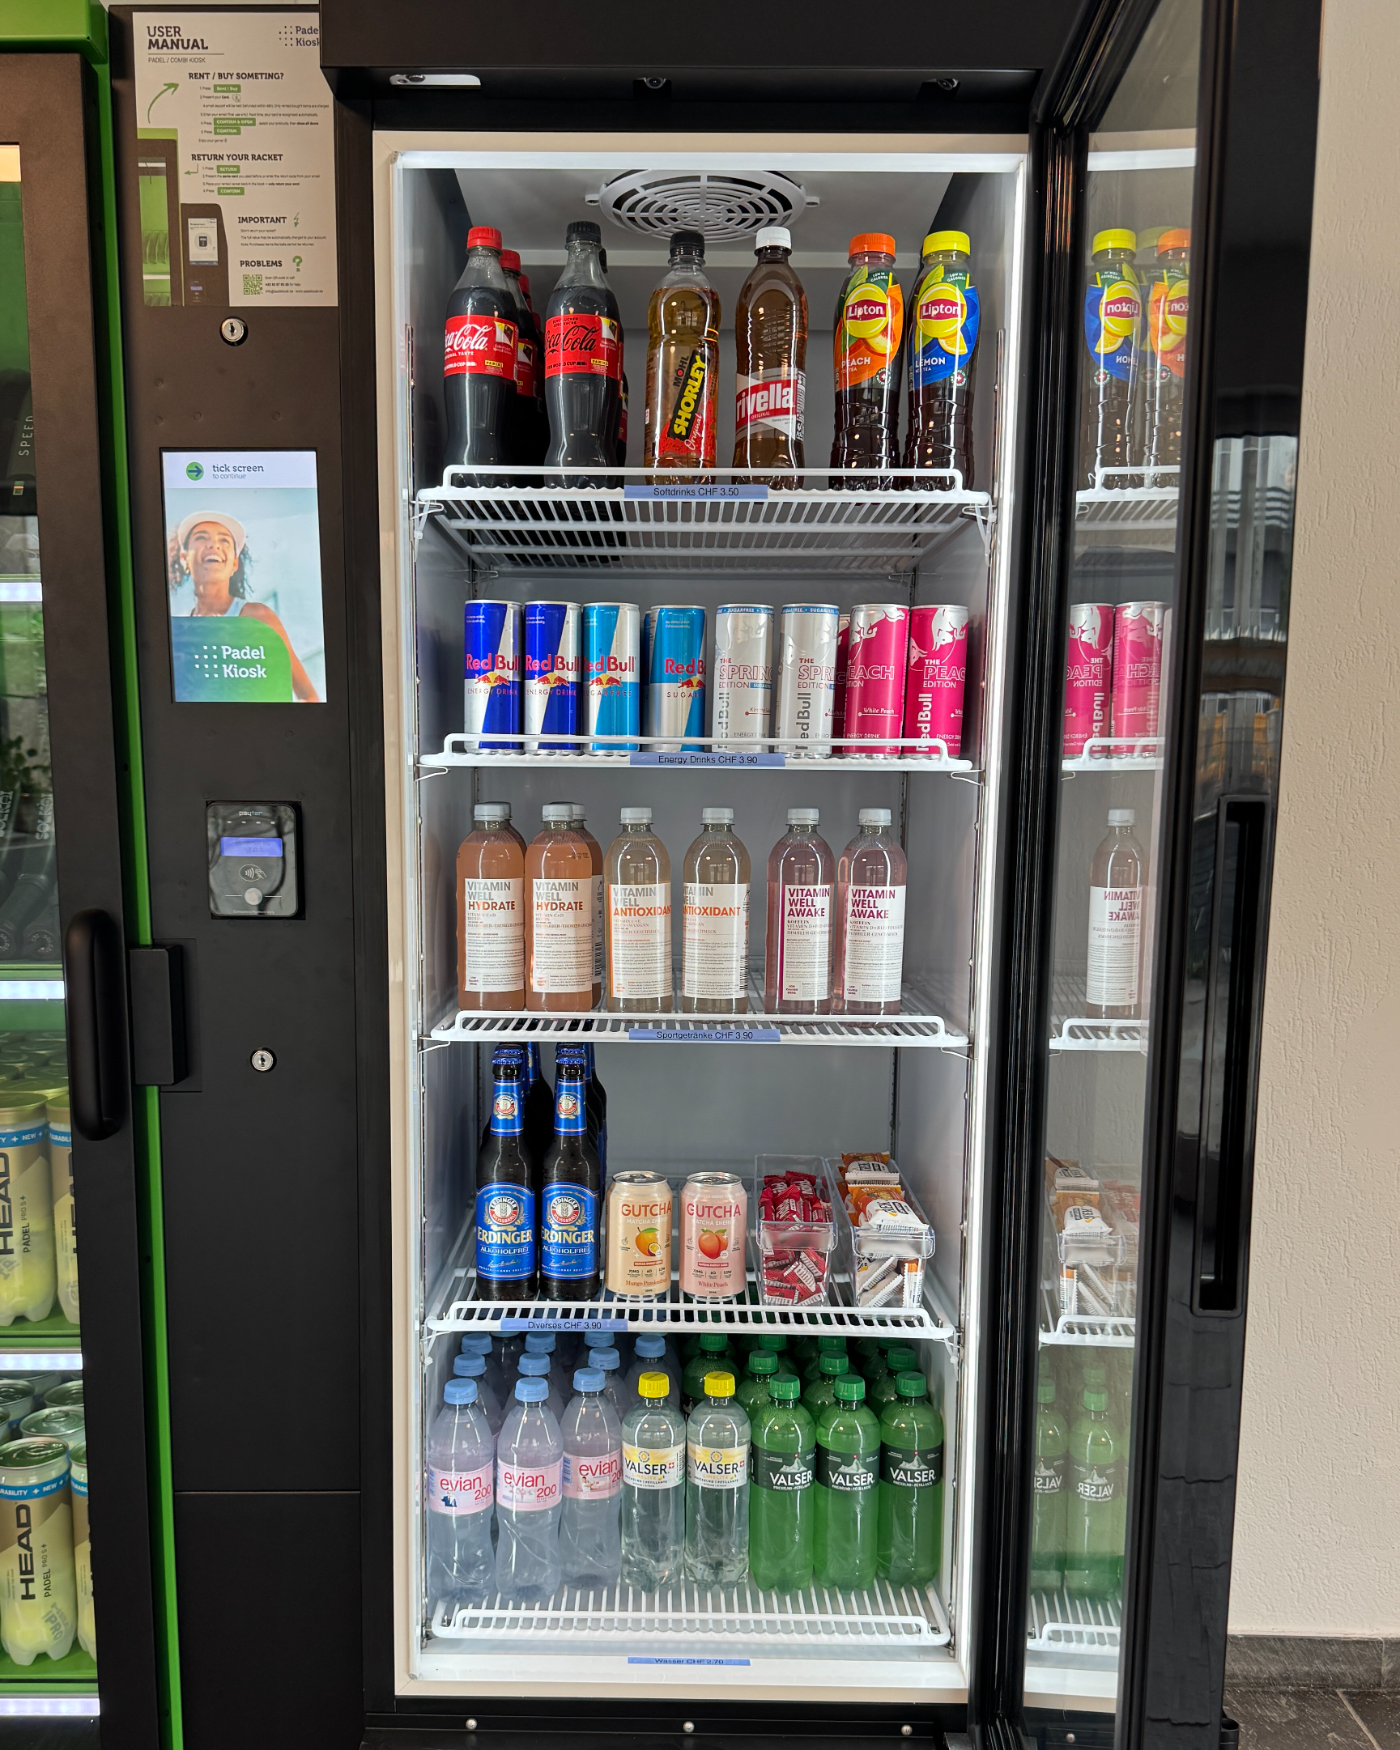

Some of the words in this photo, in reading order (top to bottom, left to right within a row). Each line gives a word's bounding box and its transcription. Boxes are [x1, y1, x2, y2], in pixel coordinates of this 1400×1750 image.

[147, 26, 182, 37] USER
[295, 26, 319, 34] Pade
[148, 39, 208, 50] MANUAL
[848, 305, 884, 317] Lipton
[922, 305, 960, 317] Lipton
[841, 357, 871, 368] PEACH
[915, 357, 945, 368] LEMON
[673, 353, 708, 436] SHORLEY
[736, 383, 794, 422] rivella
[751, 411, 770, 419] ORIGINAL
[18, 416, 33, 456] SPEED
[684, 413, 702, 450] Original
[213, 464, 230, 472] tick
[232, 464, 264, 472] screen
[653, 488, 696, 496] Softdrinks
[698, 488, 718, 496] CHF
[720, 488, 739, 496] 3.50
[222, 645, 265, 660] Padel
[466, 653, 492, 670] Red
[495, 654, 520, 671] Bull
[526, 654, 552, 670] Red
[554, 655, 581, 672] Bull
[607, 656, 635, 672] Bull
[664, 658, 694, 674] Red
[222, 664, 267, 678] Kiosk
[846, 665, 894, 680] EACH
[923, 666, 966, 681] PEAC
[718, 692, 730, 719] Bull
[797, 693, 811, 719] Bull
[918, 693, 932, 720] Bull
[658, 755, 687, 764] Energy
[690, 755, 716, 764] Drinks
[718, 756, 737, 764] CHF
[739, 756, 758, 764] 3.90
[467, 882, 511, 891] VITAMIN
[536, 882, 579, 891] VITAMIN
[613, 887, 656, 897] VITAMIN
[788, 888, 830, 898] VITAMIN
[468, 892, 494, 900] WELL
[536, 892, 562, 901] WELL
[851, 889, 896, 899] VITAMIN
[468, 901, 515, 911] HYDRATE
[536, 901, 583, 911] HYDRATE
[614, 898, 639, 907] WELL
[789, 898, 816, 907] WELL
[852, 899, 878, 908] WELL
[614, 906, 671, 917] ANTIOXIDAN
[787, 908, 825, 917] AWAKE
[850, 909, 889, 919] AWAKE
[656, 1031, 713, 1040] Sportgetränke
[715, 1031, 733, 1039] CHF
[22, 1133, 36, 1141] NEW
[0, 1153, 14, 1256] HEAD
[622, 1201, 672, 1217] GUTCHA
[687, 1203, 741, 1218] GUTCHA
[22, 1223, 30, 1253] PADEL
[478, 1226, 533, 1244] ERDINGER
[541, 1226, 594, 1244] ERDINGER
[480, 1246, 529, 1254] ALKOHOLFREI
[543, 1244, 590, 1254] ALKOHOLFREI
[528, 1321, 562, 1329] Diverses
[579, 1458, 617, 1476] evian
[624, 1458, 668, 1475] VALSER
[694, 1459, 739, 1475] VALSER
[504, 1472, 545, 1488] evian
[770, 1470, 812, 1486] VALSER
[829, 1470, 874, 1487] VALSER
[890, 1467, 935, 1483] VALSER
[42, 1482, 57, 1492] NEW
[440, 1476, 482, 1492] evian
[474, 1484, 491, 1500] 200
[536, 1484, 557, 1498] 200
[15, 1503, 36, 1601] HEAD
